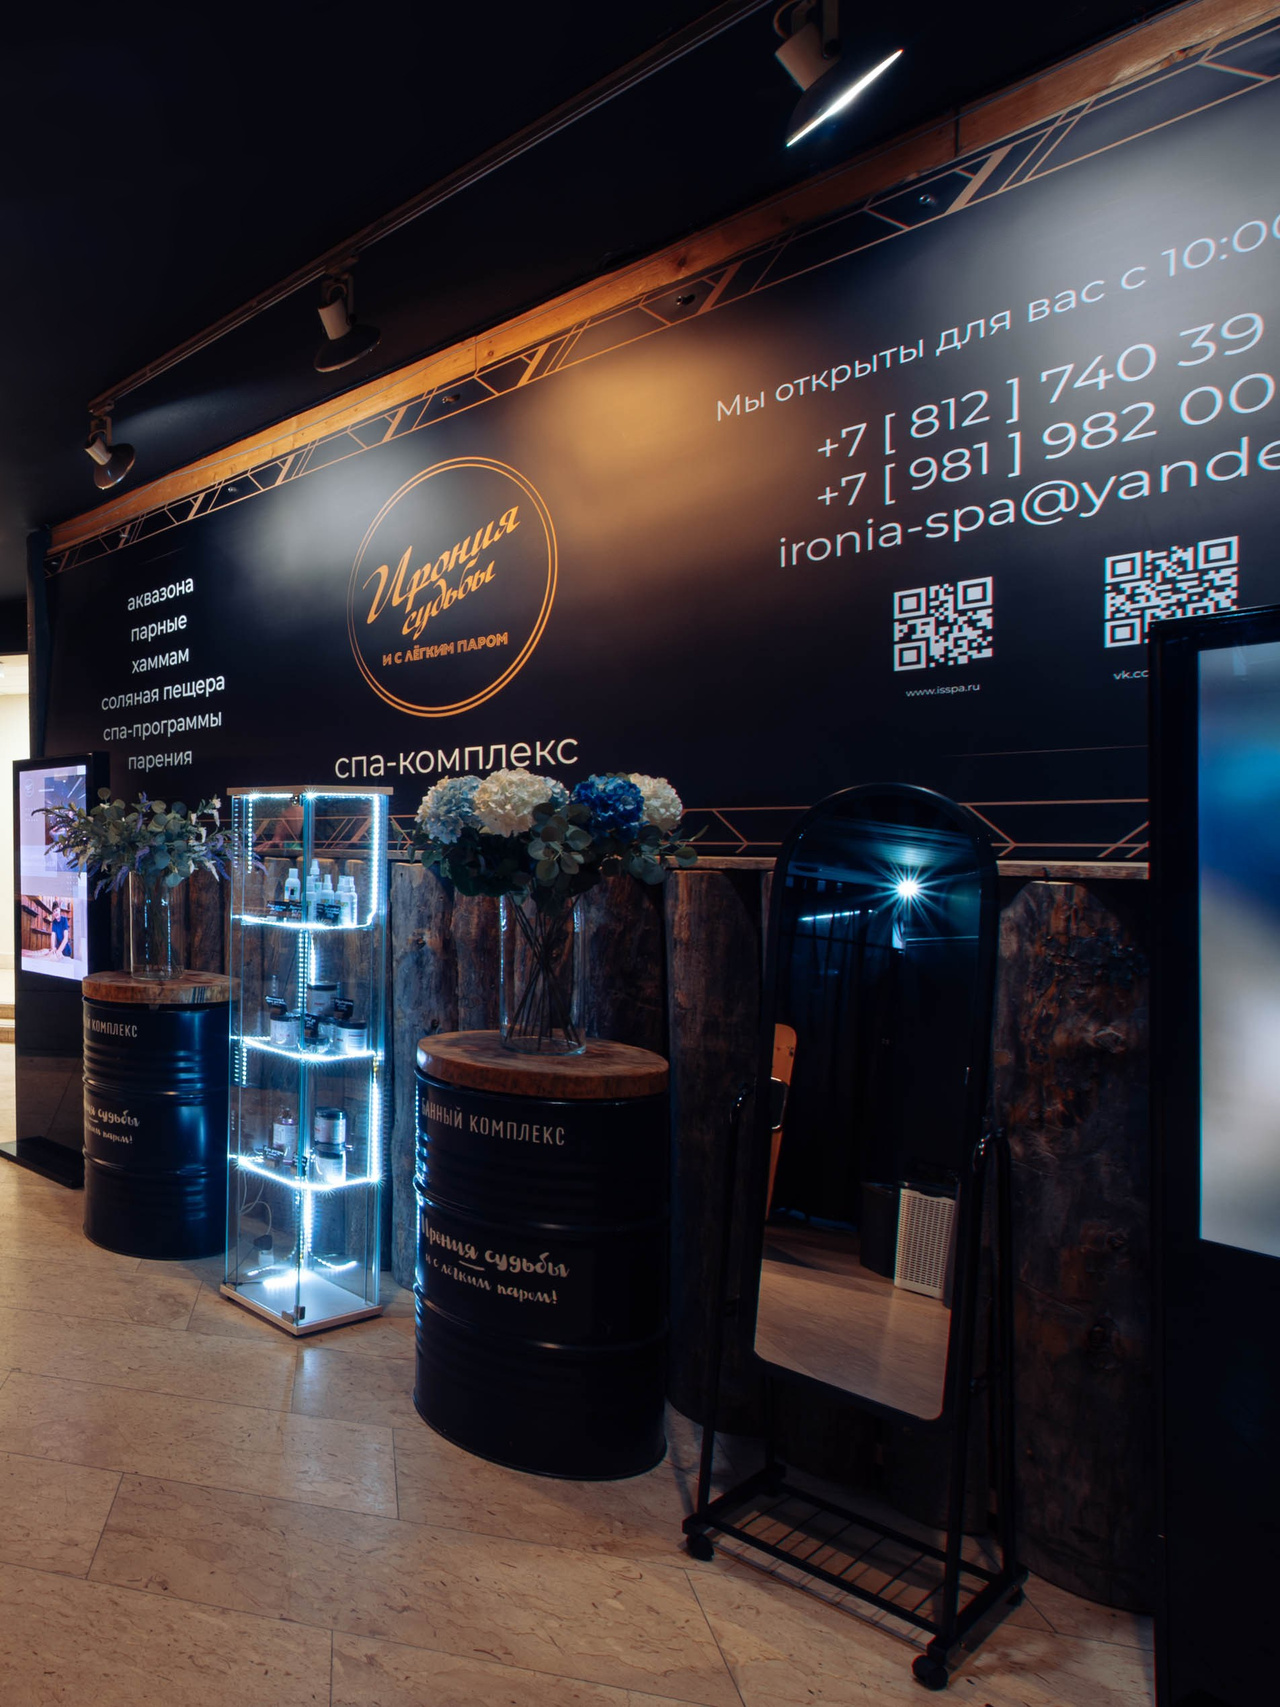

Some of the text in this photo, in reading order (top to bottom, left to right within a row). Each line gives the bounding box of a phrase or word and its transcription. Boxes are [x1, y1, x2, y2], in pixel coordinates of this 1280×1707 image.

[717, 214, 1280, 422] Мы открыты для вас с 10:0
[817, 422, 867, 458] +7
[909, 390, 990, 439] 812
[1040, 343, 1157, 404] 740
[1177, 312, 1265, 367] 39
[817, 472, 867, 506] +7
[909, 441, 988, 491] 981
[1042, 401, 1158, 460] 982
[1179, 372, 1276, 426] 00
[362, 505, 521, 624] Ирония
[127, 577, 194, 611] аквазона
[401, 554, 496, 641] судьбы
[131, 614, 188, 642] парные
[131, 648, 190, 674] хаммам
[382, 632, 509, 667] И С ЛЁГКИМ ПАРОМ
[101, 675, 225, 711] соляная пещера
[905, 682, 981, 697] www.isspa.ru
[103, 711, 222, 741] спа-программы
[128, 750, 193, 773] парения
[334, 738, 578, 779] спа-комплекс
[92, 1019, 138, 1038] КОМПЛЕКС
[470, 1114, 565, 1146] КОМПЛЕКС
[484, 1250, 570, 1278] судьбы
[497, 1284, 558, 1305] паром!
